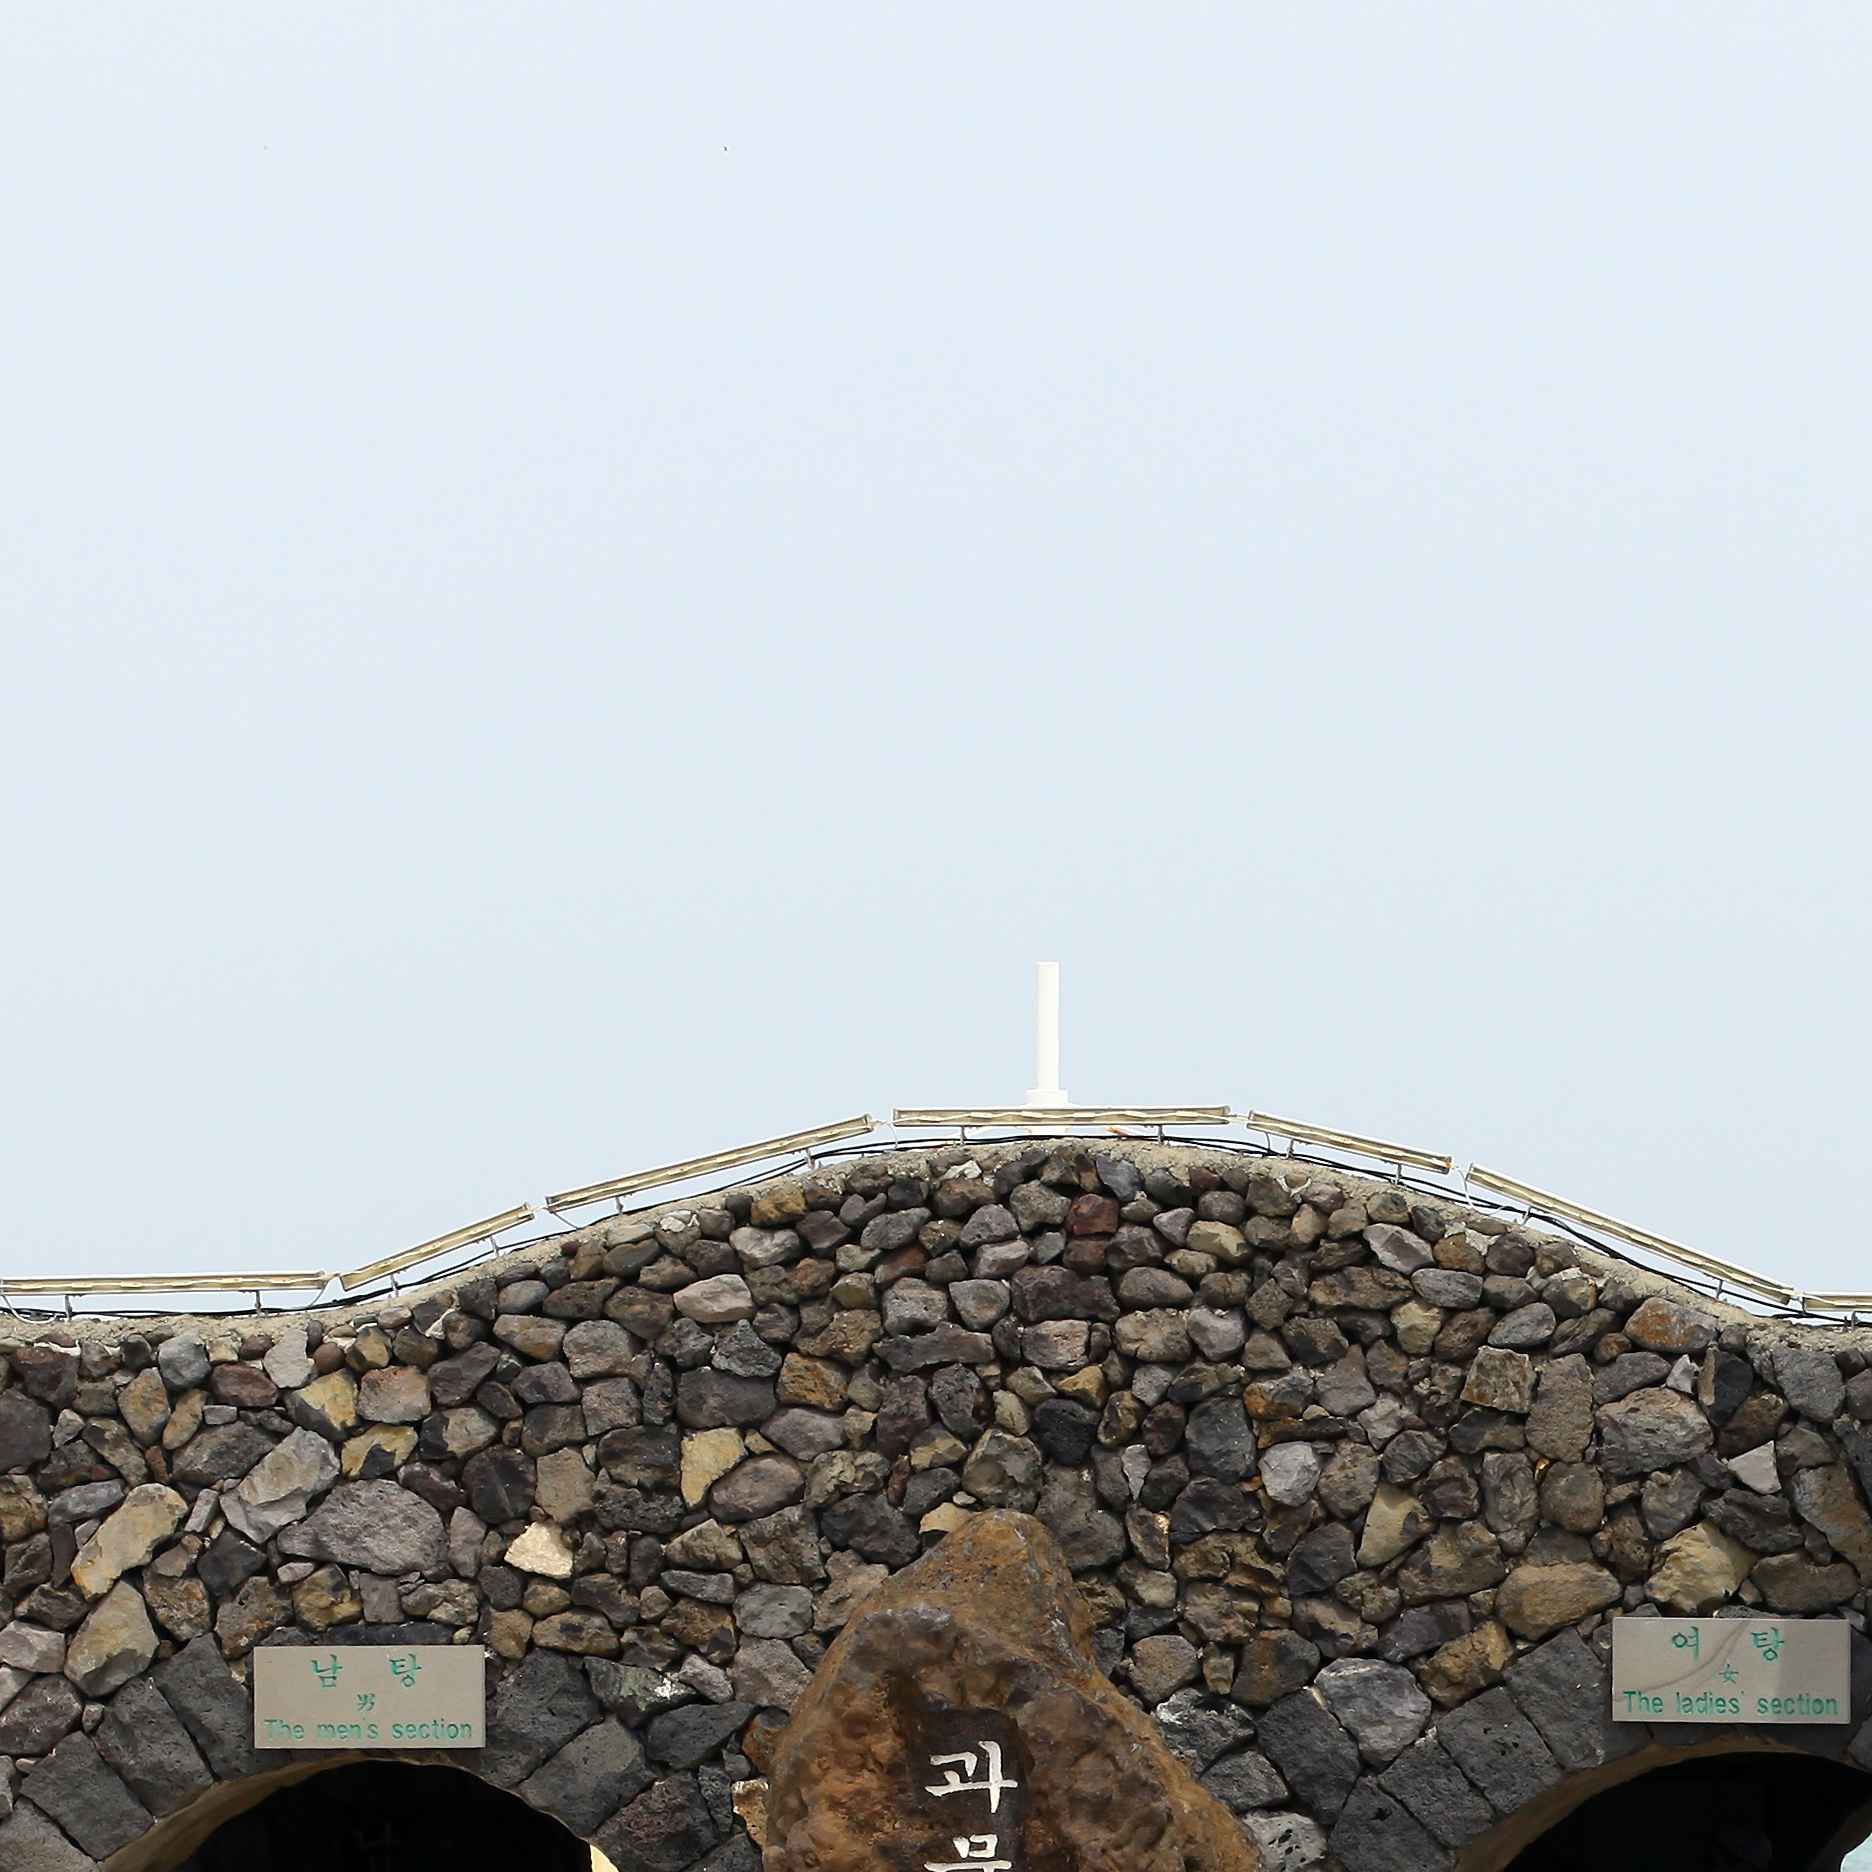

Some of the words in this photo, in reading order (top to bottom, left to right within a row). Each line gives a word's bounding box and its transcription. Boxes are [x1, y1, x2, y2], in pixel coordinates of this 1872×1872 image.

[1718, 1662, 1739, 1683] 女
[1622, 1689, 1665, 1715] The
[1675, 1688, 1745, 1715] ladies'
[1756, 1691, 1840, 1717] section
[263, 1718, 305, 1742] The
[315, 1719, 380, 1741] men's
[390, 1717, 473, 1741] section
